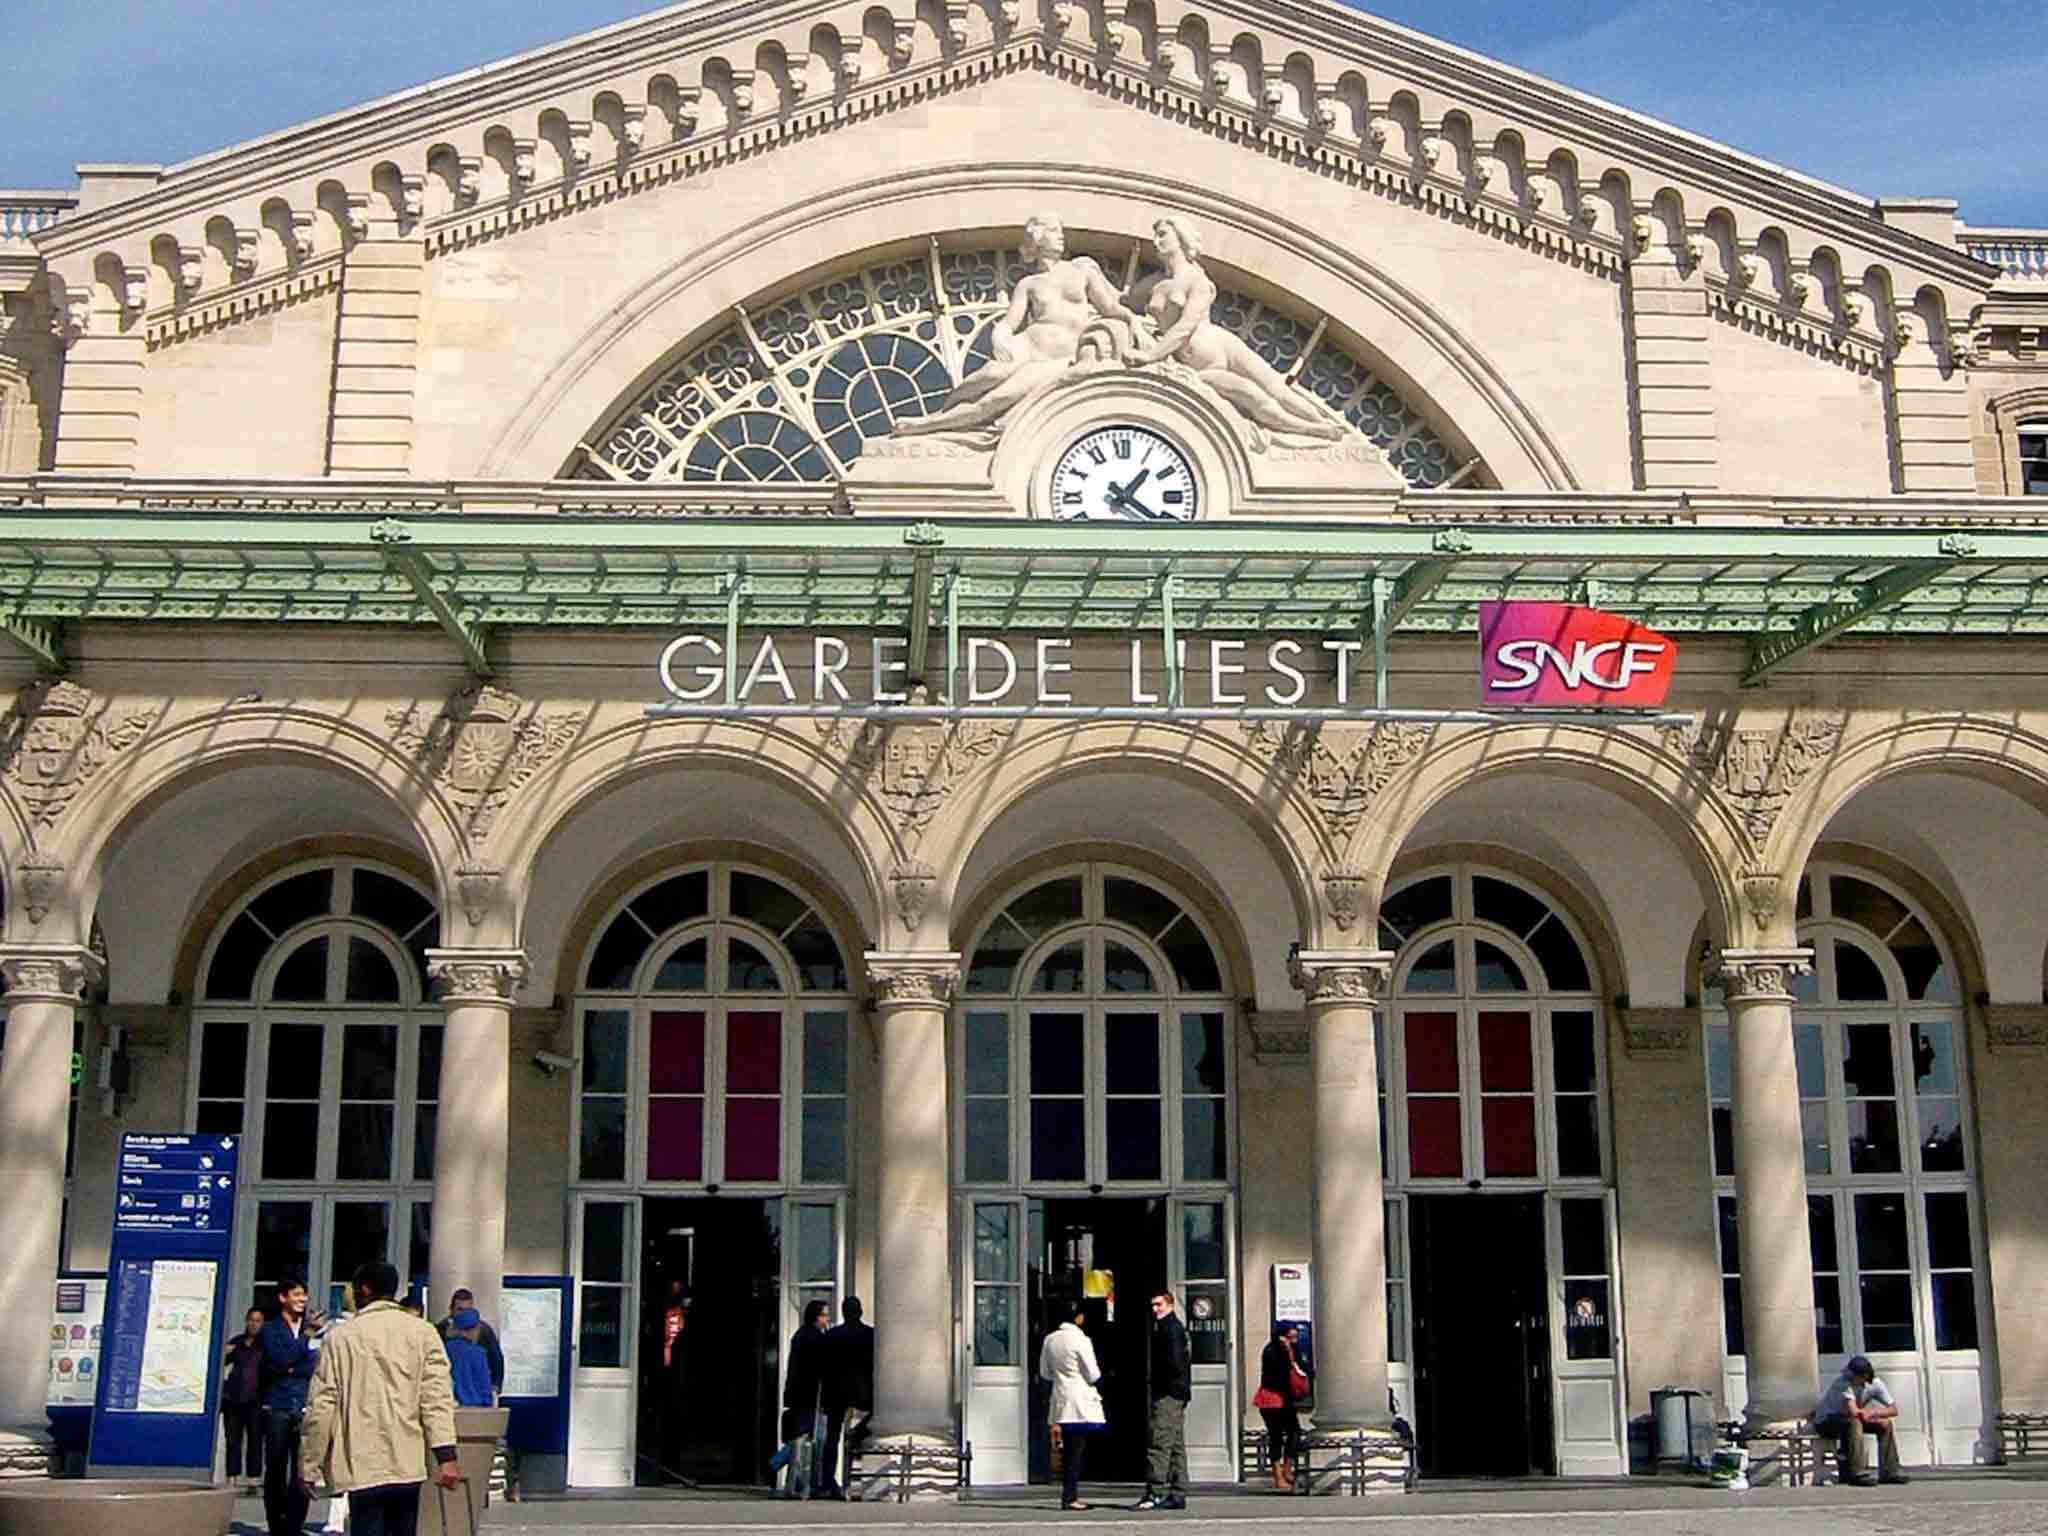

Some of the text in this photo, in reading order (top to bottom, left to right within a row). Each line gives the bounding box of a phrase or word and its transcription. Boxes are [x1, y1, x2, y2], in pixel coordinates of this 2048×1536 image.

[659, 634, 1361, 705] GARE DE L'EST
[1489, 640, 1665, 690] SNCF
